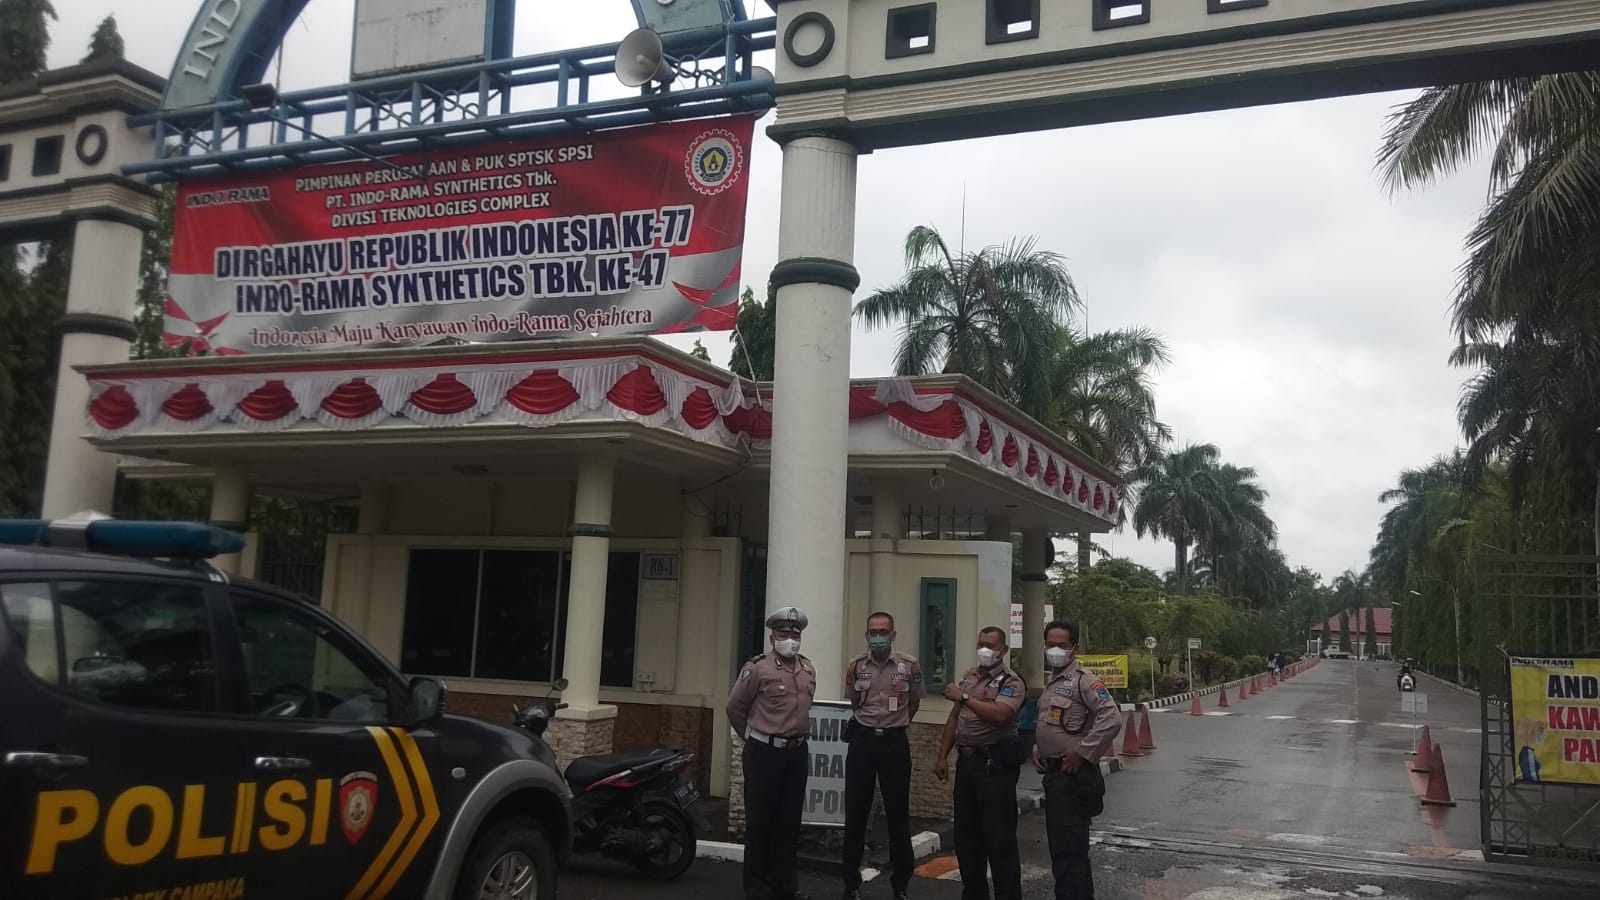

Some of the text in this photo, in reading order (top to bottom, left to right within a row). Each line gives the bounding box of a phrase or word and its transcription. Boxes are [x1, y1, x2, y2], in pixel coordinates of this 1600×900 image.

[295, 173, 361, 192] PIMPINAN
[461, 159, 471, 173] &
[475, 154, 505, 171] PUK
[508, 148, 554, 168] SPTSK
[558, 144, 594, 162] SPSI
[326, 171, 557, 209] PT. INDO-RAMA SYNTHETICS Tbk.
[332, 192, 550, 228] DIVISI TEKNOLOGIES COMPLEX
[215, 207, 692, 279] DIRGAHAYU REPUBLIK INDONESIA KE-77
[236, 252, 668, 314] INDO-RAMA SYNTHETICS TBK. KE-47
[250, 305, 652, 347] Indonesia Maju Karyawan Indo-Rama Sejahtera
[1547, 674, 1600, 699] AND
[25, 778, 333, 875] POLISI
